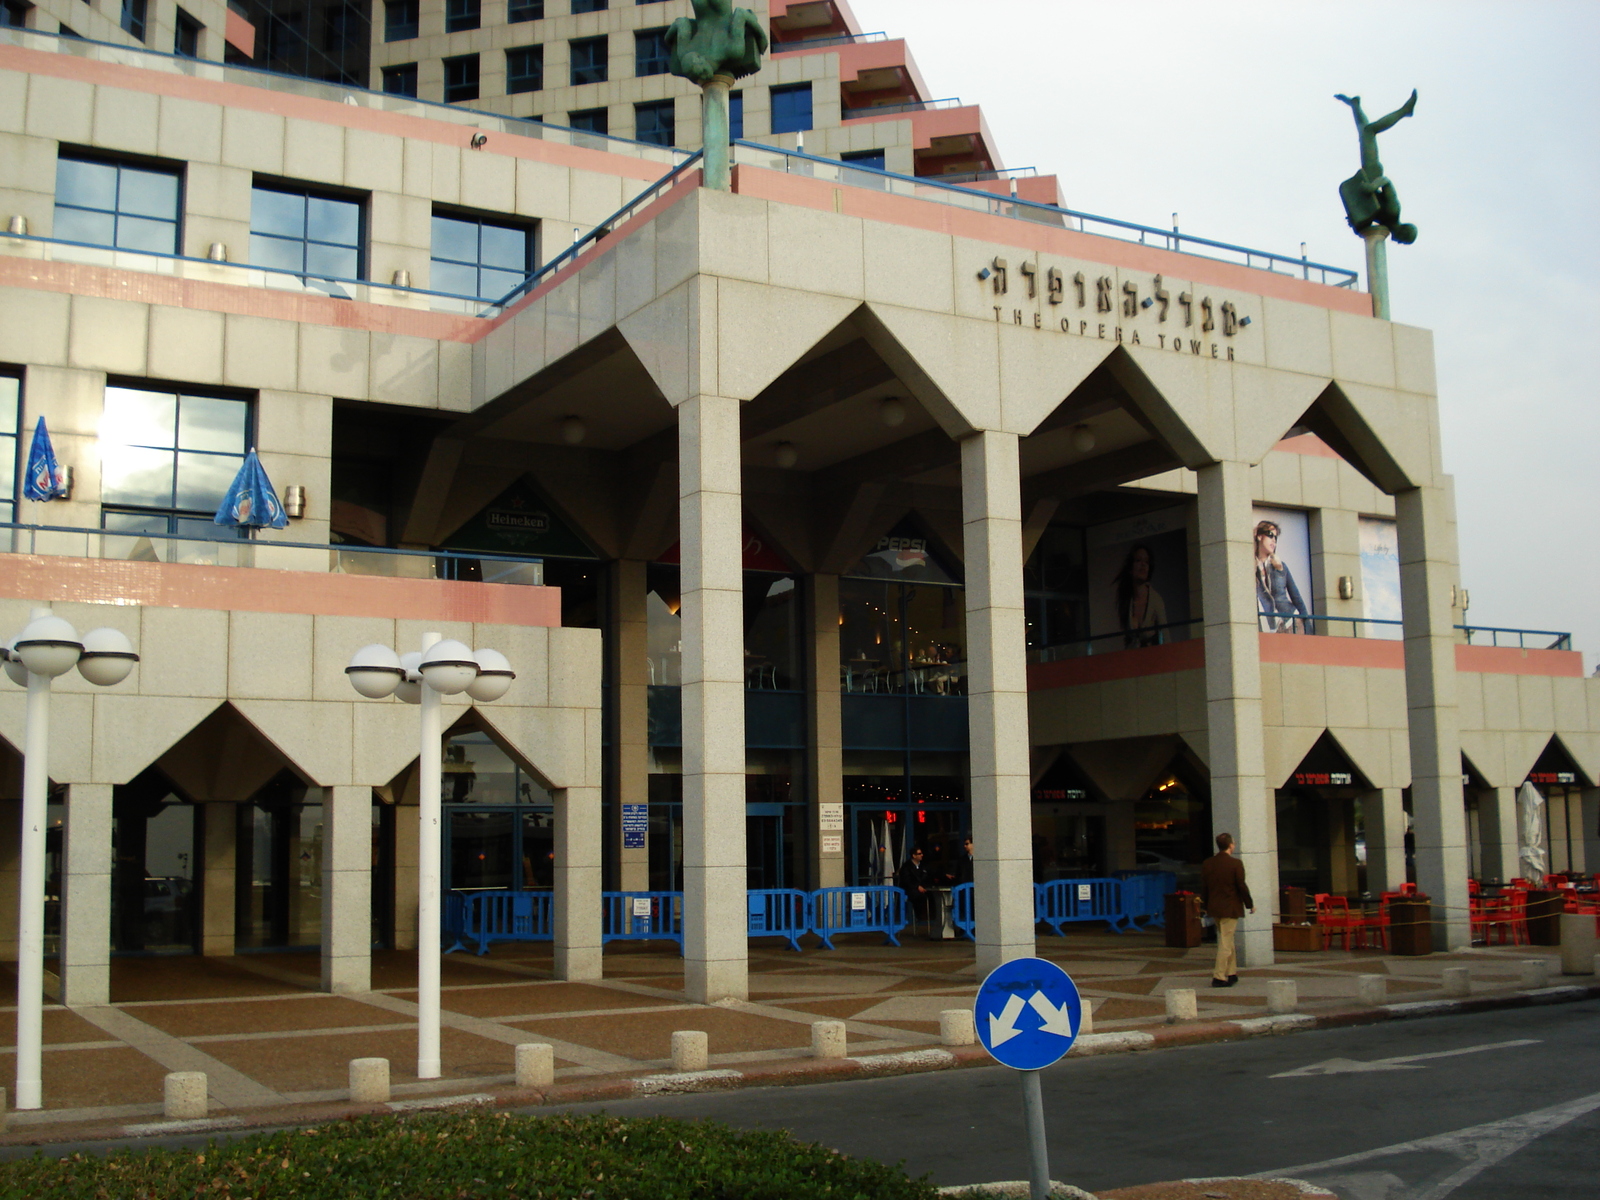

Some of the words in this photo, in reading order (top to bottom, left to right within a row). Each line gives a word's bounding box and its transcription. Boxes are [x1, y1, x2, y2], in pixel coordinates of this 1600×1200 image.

[992, 255, 1139, 318] האופרה
[1153, 273, 1238, 337] מגדל
[993, 305, 1042, 329] THE
[1060, 317, 1141, 346] OPERA
[1157, 333, 1235, 362] TOWER
[490, 513, 545, 528] Heineken
[876, 536, 927, 554] PEPSI
